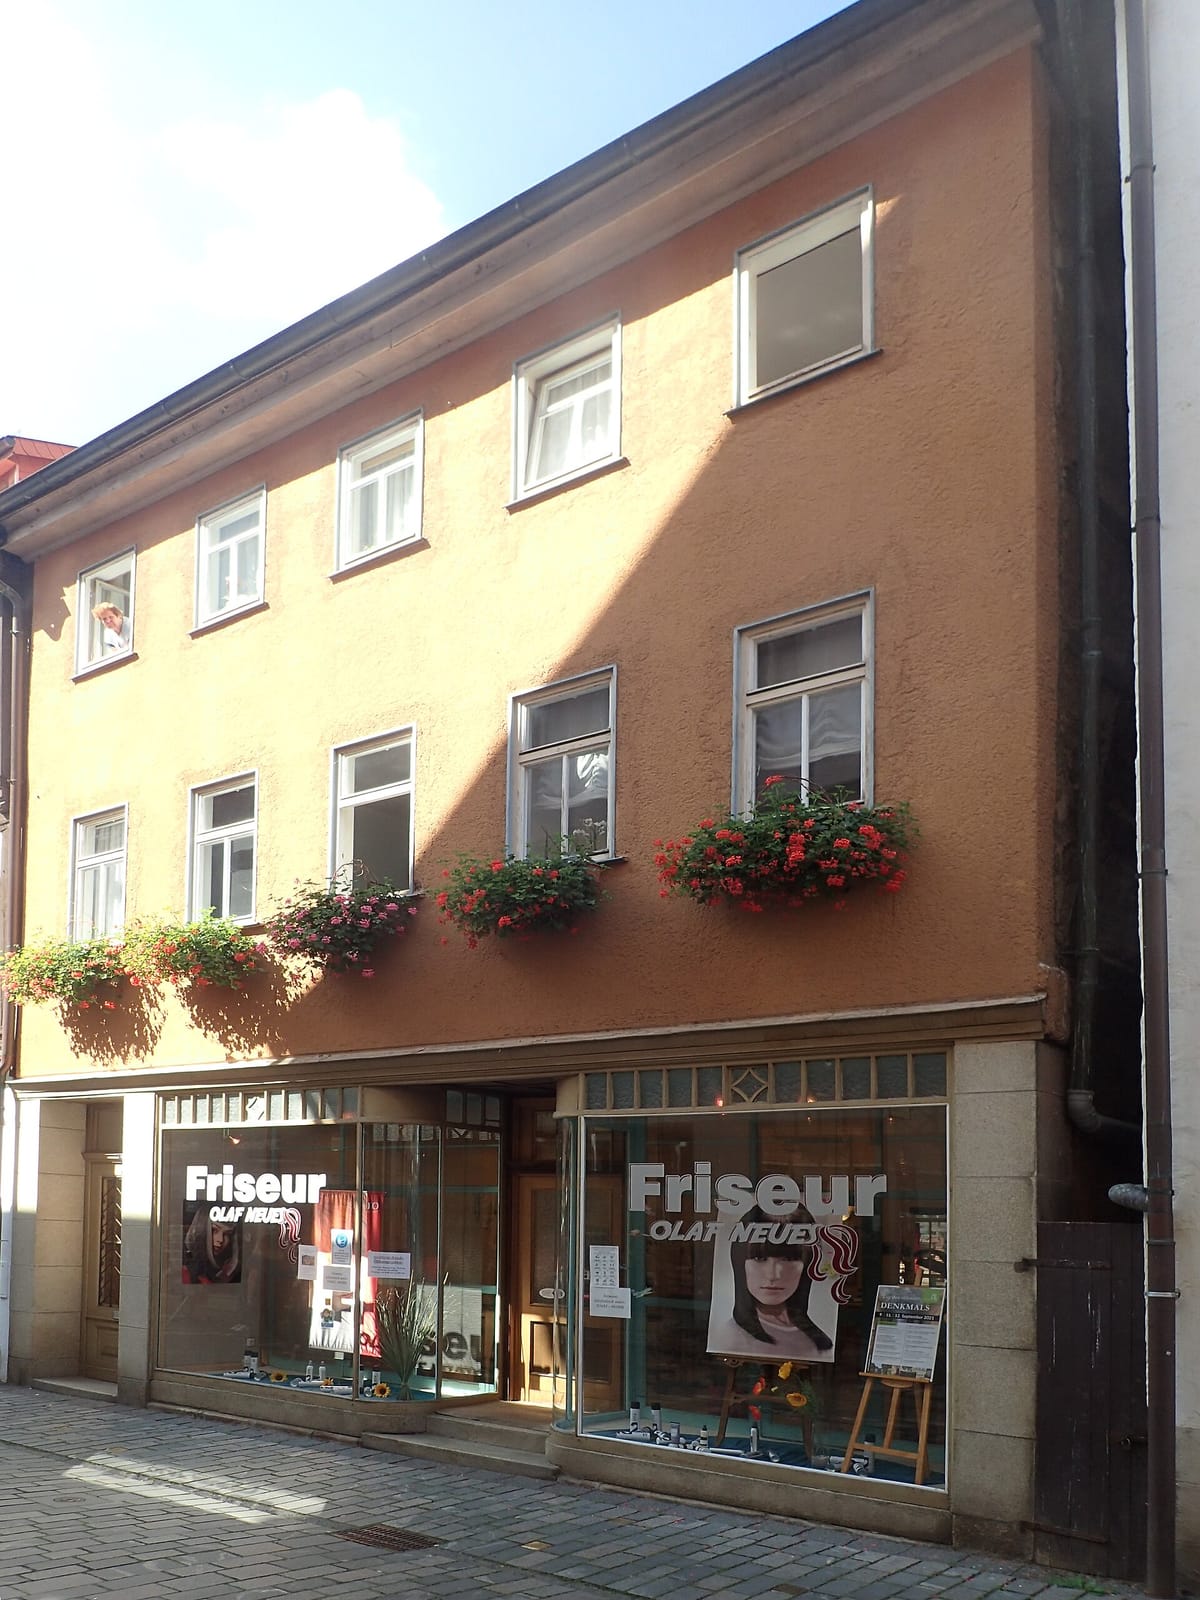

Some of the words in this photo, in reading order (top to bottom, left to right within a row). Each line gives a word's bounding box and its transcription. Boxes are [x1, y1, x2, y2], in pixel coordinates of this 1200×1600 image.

[185, 1164, 327, 1204] Friseur
[629, 1161, 888, 1217] Friseur
[209, 1206, 244, 1222] OLAF
[650, 1220, 722, 1241] OLAF
[880, 1302, 930, 1312] DENKMALS
